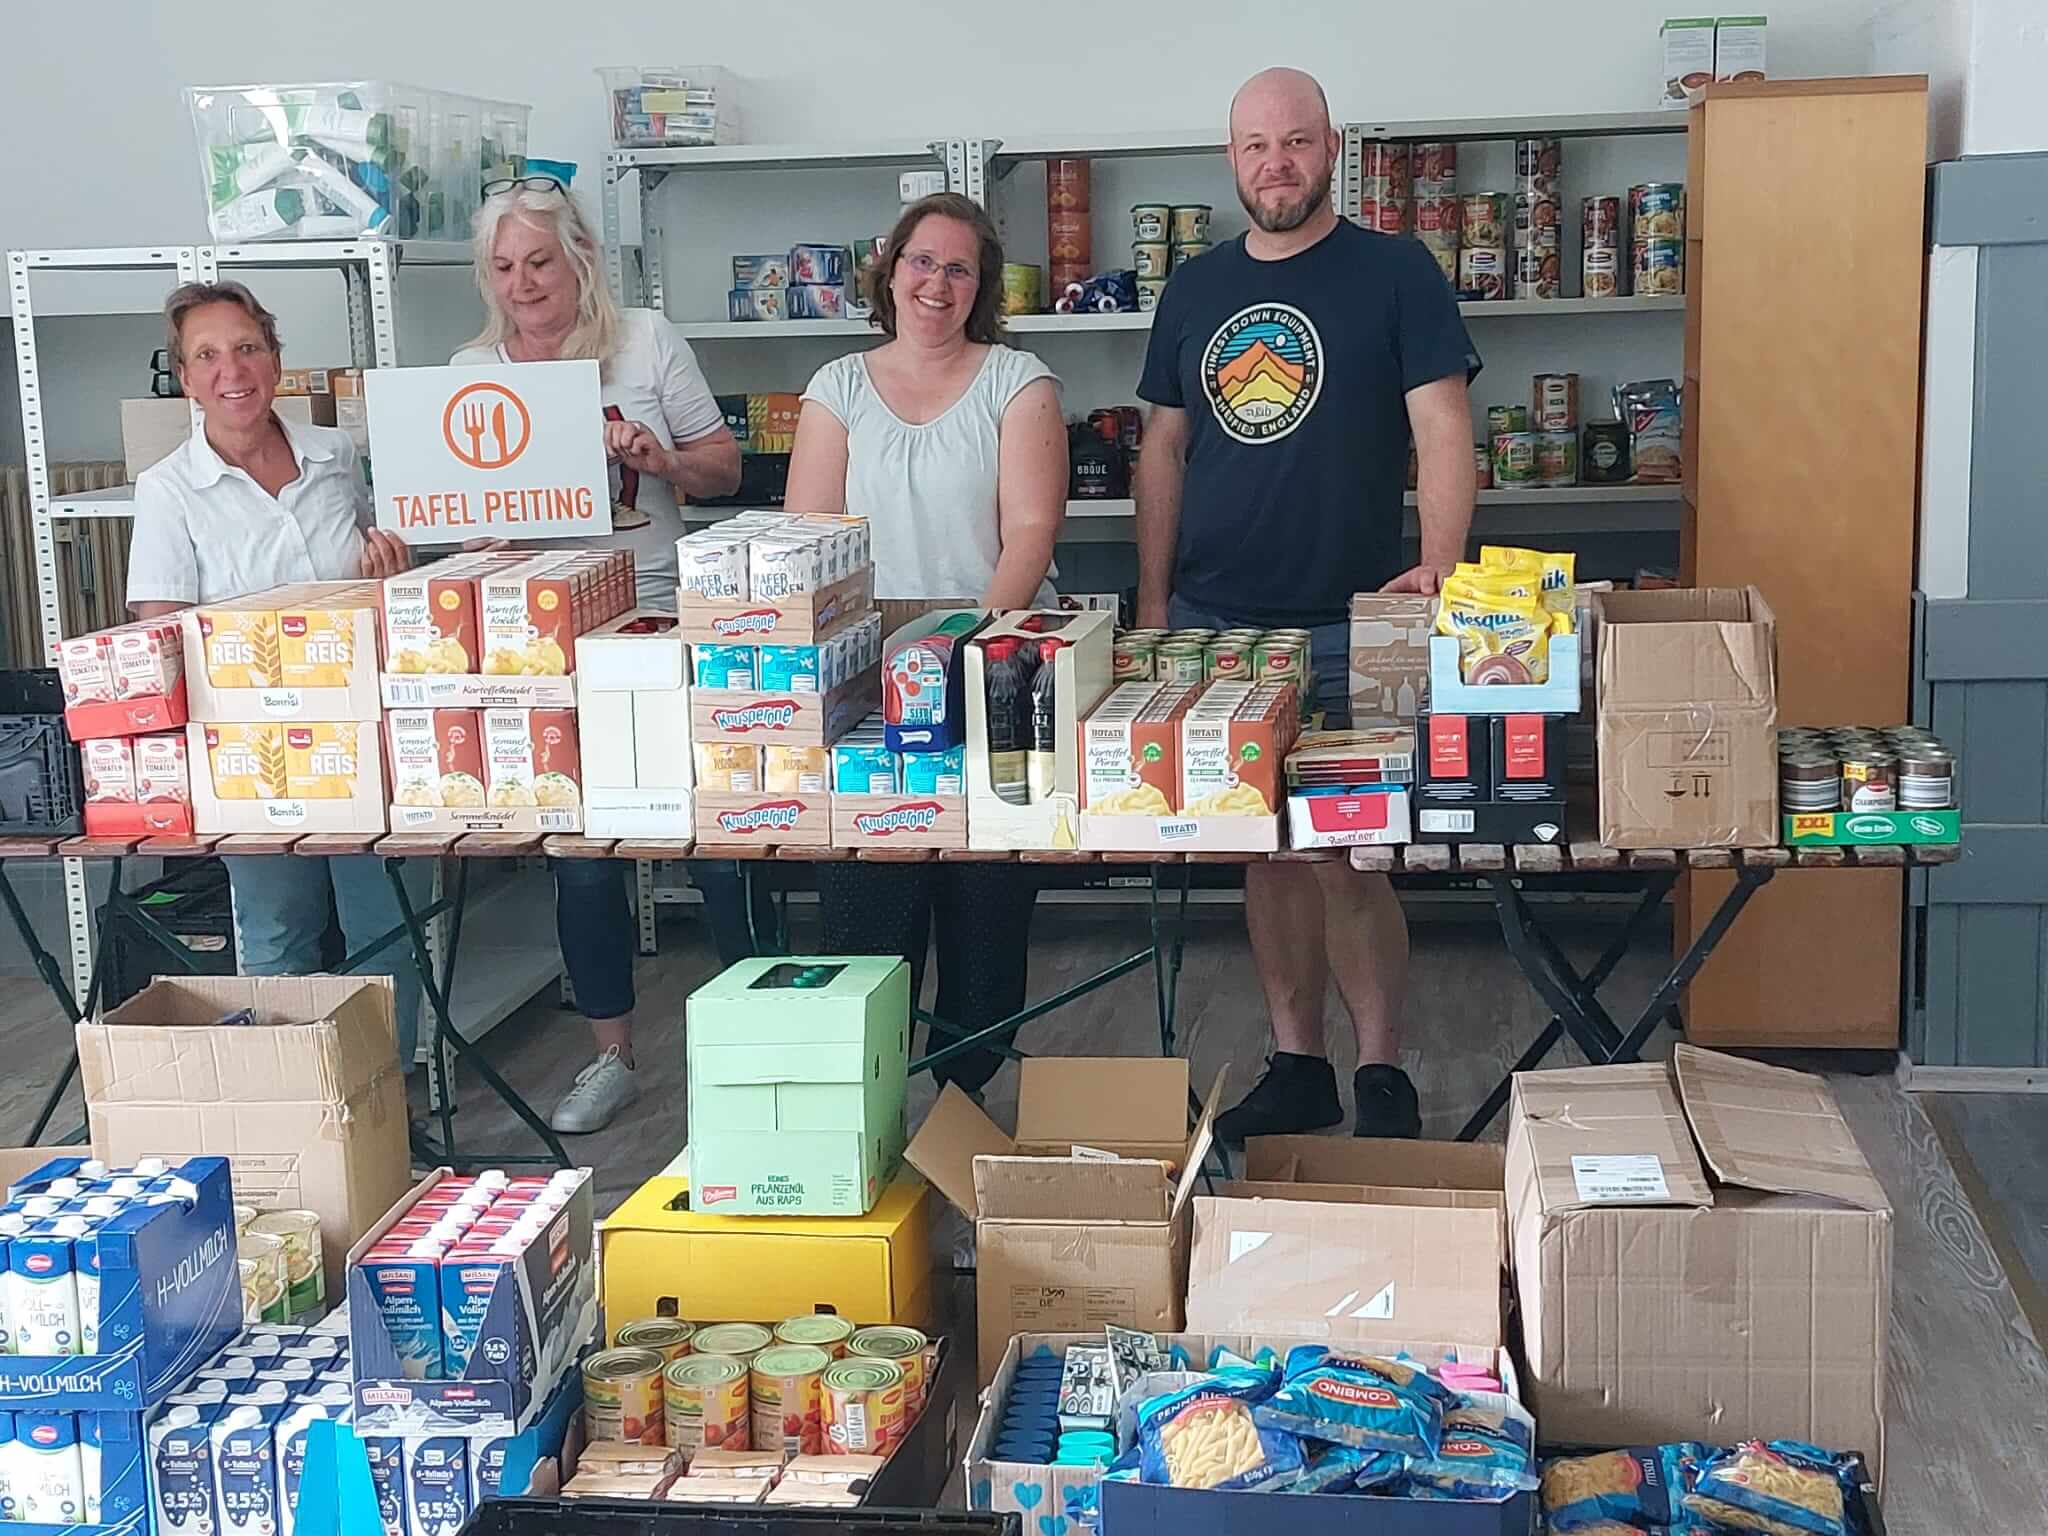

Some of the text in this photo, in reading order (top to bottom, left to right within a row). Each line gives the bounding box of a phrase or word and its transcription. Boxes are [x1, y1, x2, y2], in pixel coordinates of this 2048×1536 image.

[1207, 311, 1316, 375] FINEST DOWN EQUIPMENT
[1261, 389, 1310, 435] ENGLAND
[393, 487, 594, 529] TAFEL PEITING
[715, 613, 776, 633] Knusperone
[210, 642, 254, 665] REIS
[304, 641, 348, 665] REIS
[717, 706, 792, 729] Knusperone
[216, 754, 259, 776] REIS
[311, 754, 354, 776] REIS
[722, 809, 798, 829] Knusperone
[859, 810, 935, 833] Knusperone
[751, 1182, 805, 1195] PFLANZENÖL
[755, 1195, 802, 1206] AUS RAPS
[156, 1223, 228, 1309] H-VOLLMILCH
[382, 1305, 421, 1314] ollmilch
[0, 1375, 102, 1393] H-VOLLMILCH
[1318, 1380, 1391, 1402] COMBINO
[367, 1391, 408, 1401] MILSANI
[1157, 1394, 1198, 1421] PENNE
